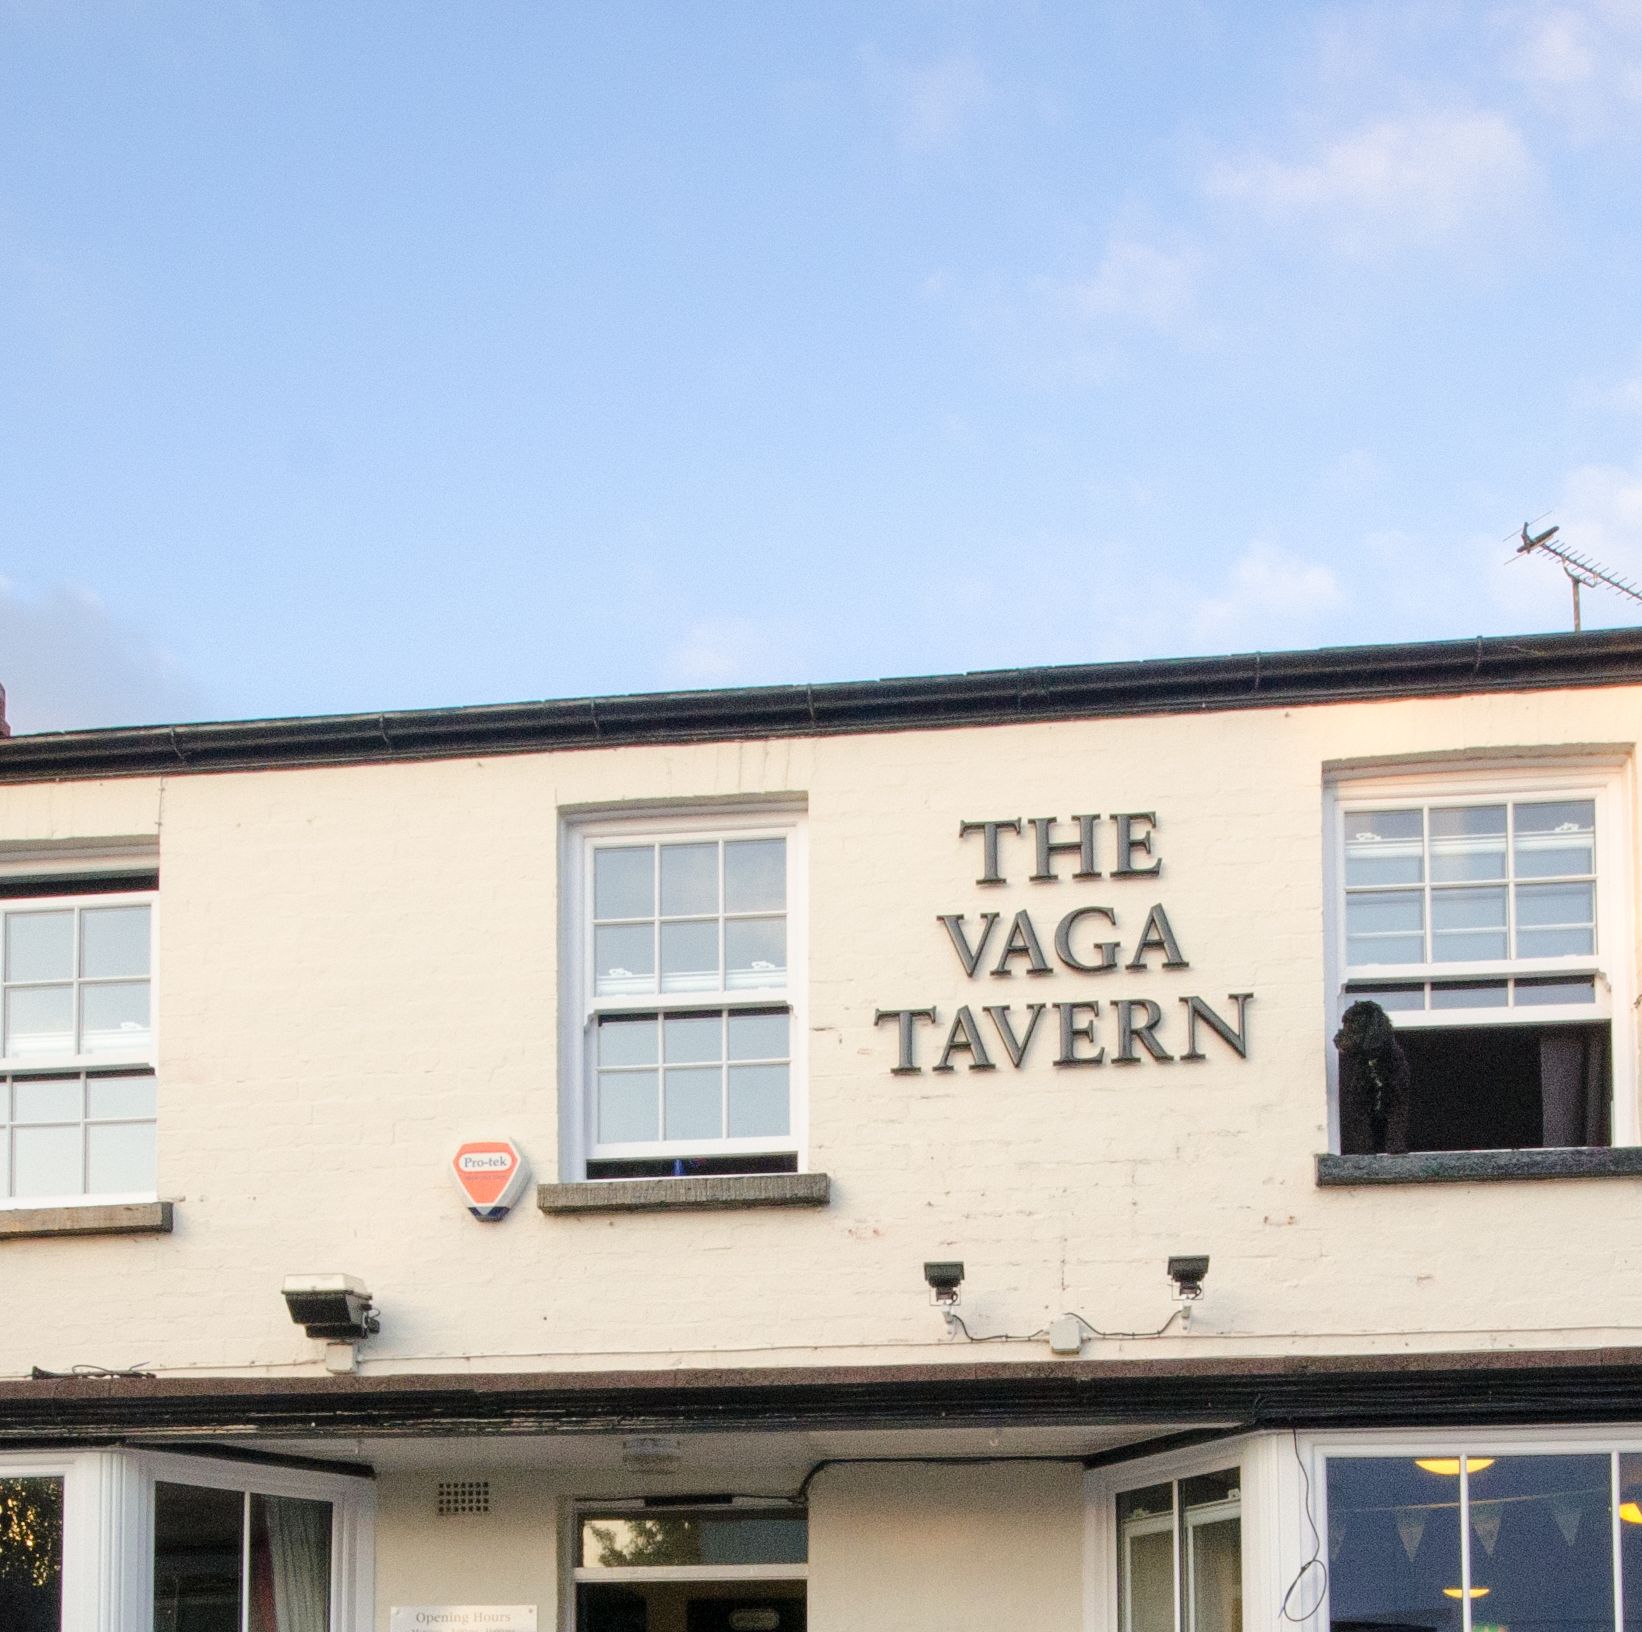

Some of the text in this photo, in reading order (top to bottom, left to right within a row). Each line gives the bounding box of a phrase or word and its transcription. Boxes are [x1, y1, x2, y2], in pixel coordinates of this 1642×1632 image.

[959, 811, 1162, 885] THE
[936, 903, 1189, 978] VAGA
[874, 992, 1254, 1075] TAVERN
[463, 1156, 508, 1168] Pro-tek
[415, 1612, 511, 1625] Opening Hours
